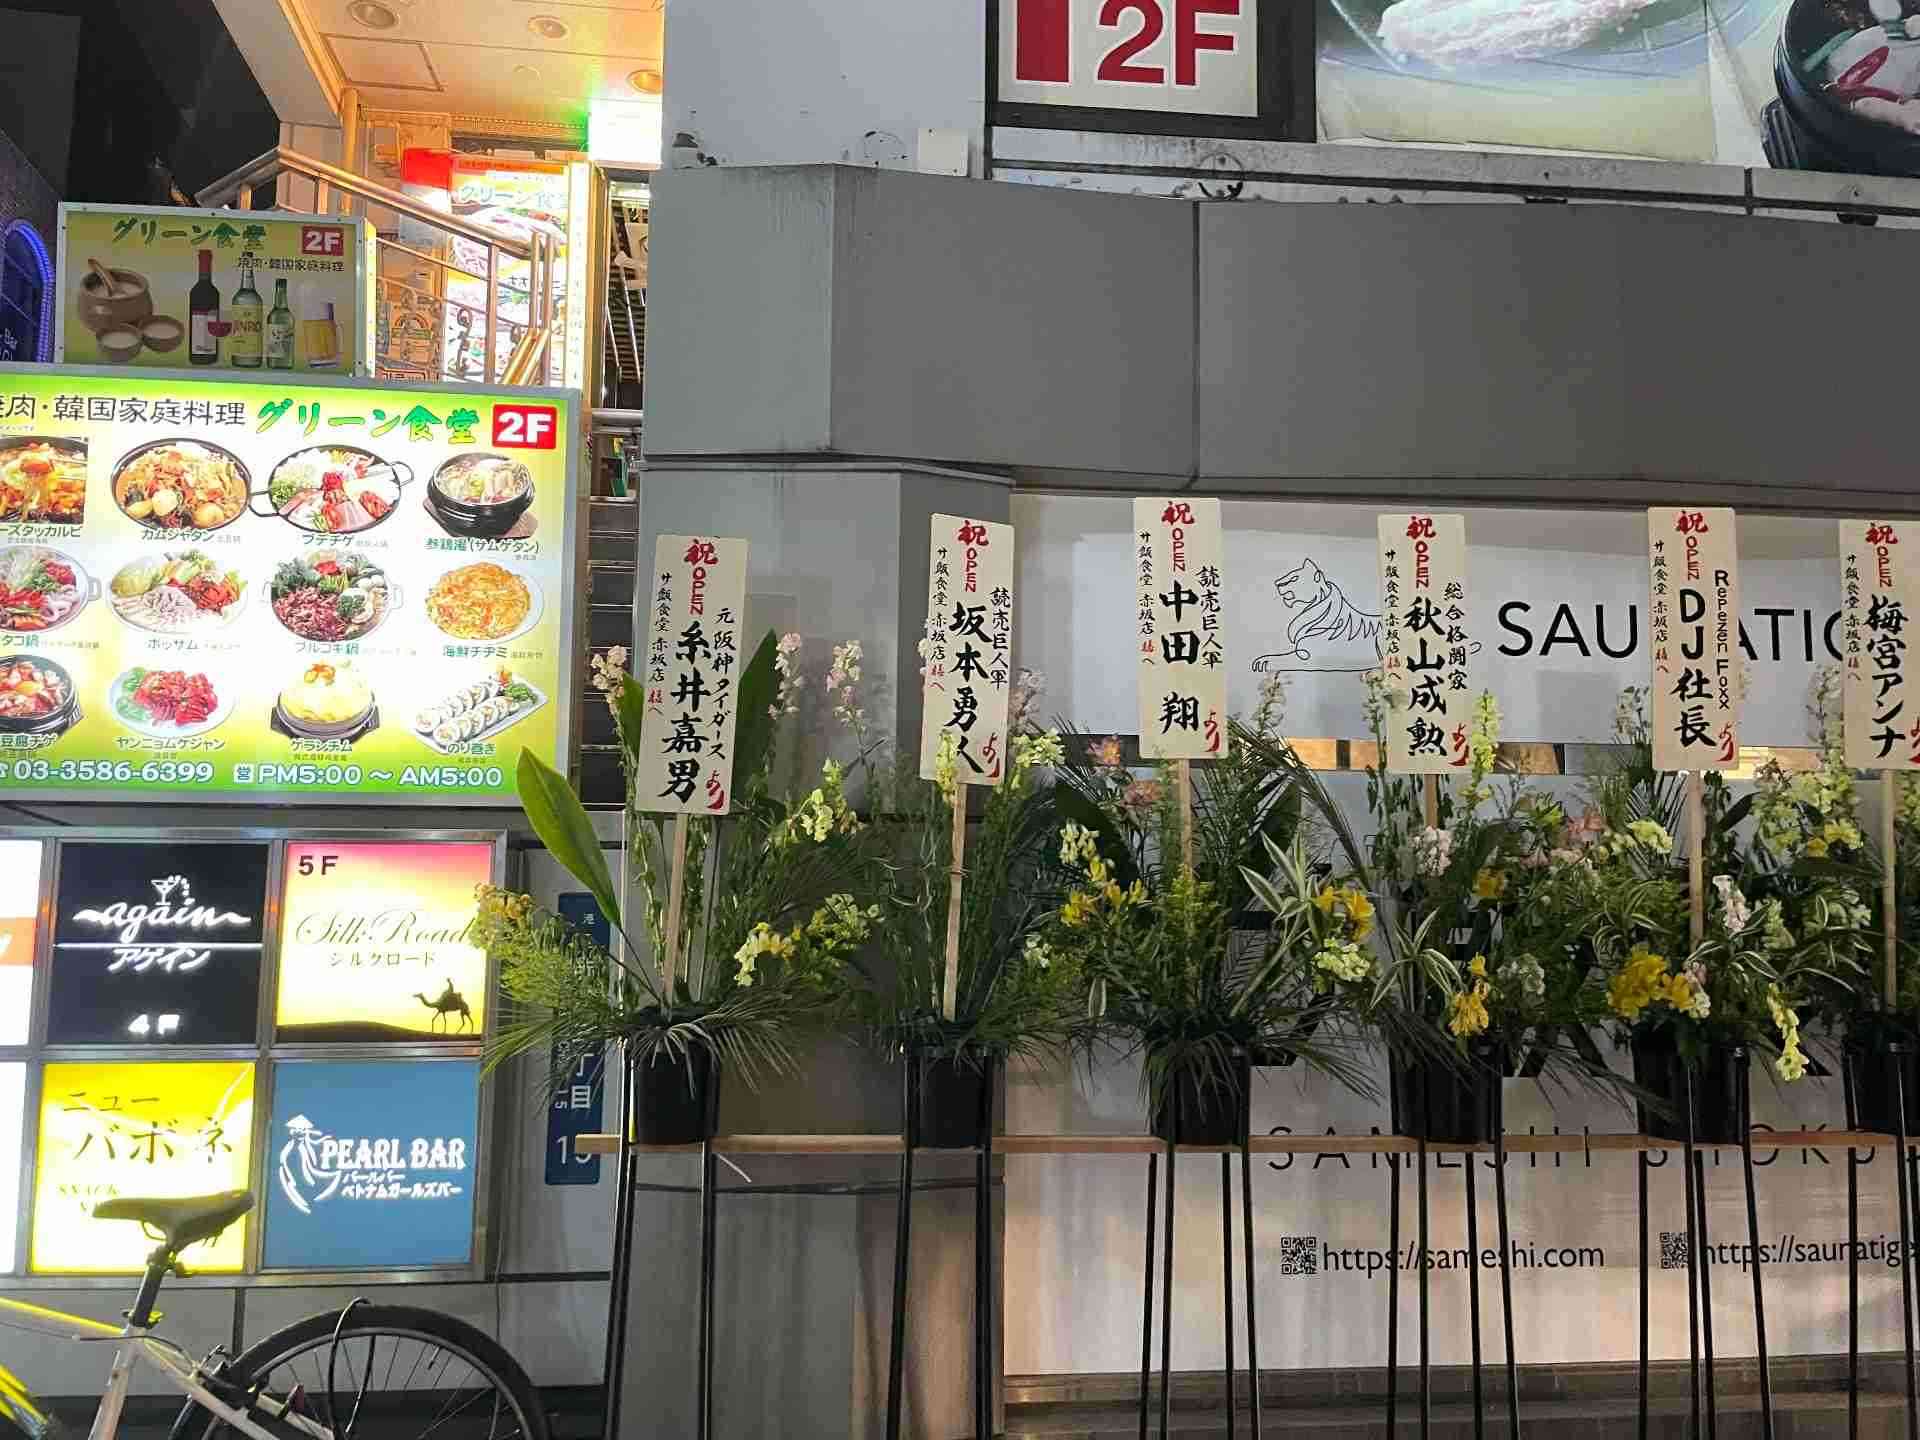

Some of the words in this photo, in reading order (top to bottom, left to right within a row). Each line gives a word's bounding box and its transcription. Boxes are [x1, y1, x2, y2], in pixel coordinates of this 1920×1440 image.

[1097, 0, 1239, 86] 2F
[112, 217, 267, 251] グリーン食堂
[305, 232, 340, 252] 2F
[256, 398, 480, 445] グリーン食堂
[497, 411, 550, 444] 2F
[957, 520, 989, 546] 祝
[1161, 501, 1194, 525] 祝
[1406, 516, 1437, 539] 祝
[1676, 510, 1708, 535] 祝
[684, 539, 718, 565] 祝
[1172, 527, 1186, 572] OPEN
[1865, 523, 1898, 545] 祝
[965, 547, 977, 593] OPEN
[1415, 540, 1429, 589] OPEN
[1686, 535, 1700, 581] OPEN
[1876, 546, 1892, 588] OPEN
[690, 567, 707, 615] OPEN
[1159, 580, 1200, 664] 中田
[1197, 566, 1222, 669] 読売巨人軍
[990, 587, 1010, 689] 読売巨人軍
[707, 608, 736, 760] 元阪神タイガース
[1403, 596, 1448, 757] 秋山成勲
[1671, 588, 1718, 747] DJ社長
[1863, 593, 1909, 759] 梅宮アンナ
[657, 620, 711, 804] 糸井嘉男
[1160, 691, 1200, 734] 翔
[14, 760, 214, 782] 03-3586-6399
[257, 764, 362, 785] PM5:00
[400, 766, 503, 786] AM5:00
[298, 854, 339, 877] 5F
[73, 902, 251, 943] again
[295, 911, 372, 945] Silk
[371, 905, 476, 944] Road
[329, 952, 437, 968] シルクロード
[63, 1091, 161, 1112] ニュー
[320, 1137, 406, 1170] PEARL
[410, 1137, 467, 1170] BAR
[340, 1183, 463, 1200] ベトナムガールズバー
[1322, 1239, 1605, 1279] https://samehi.com
